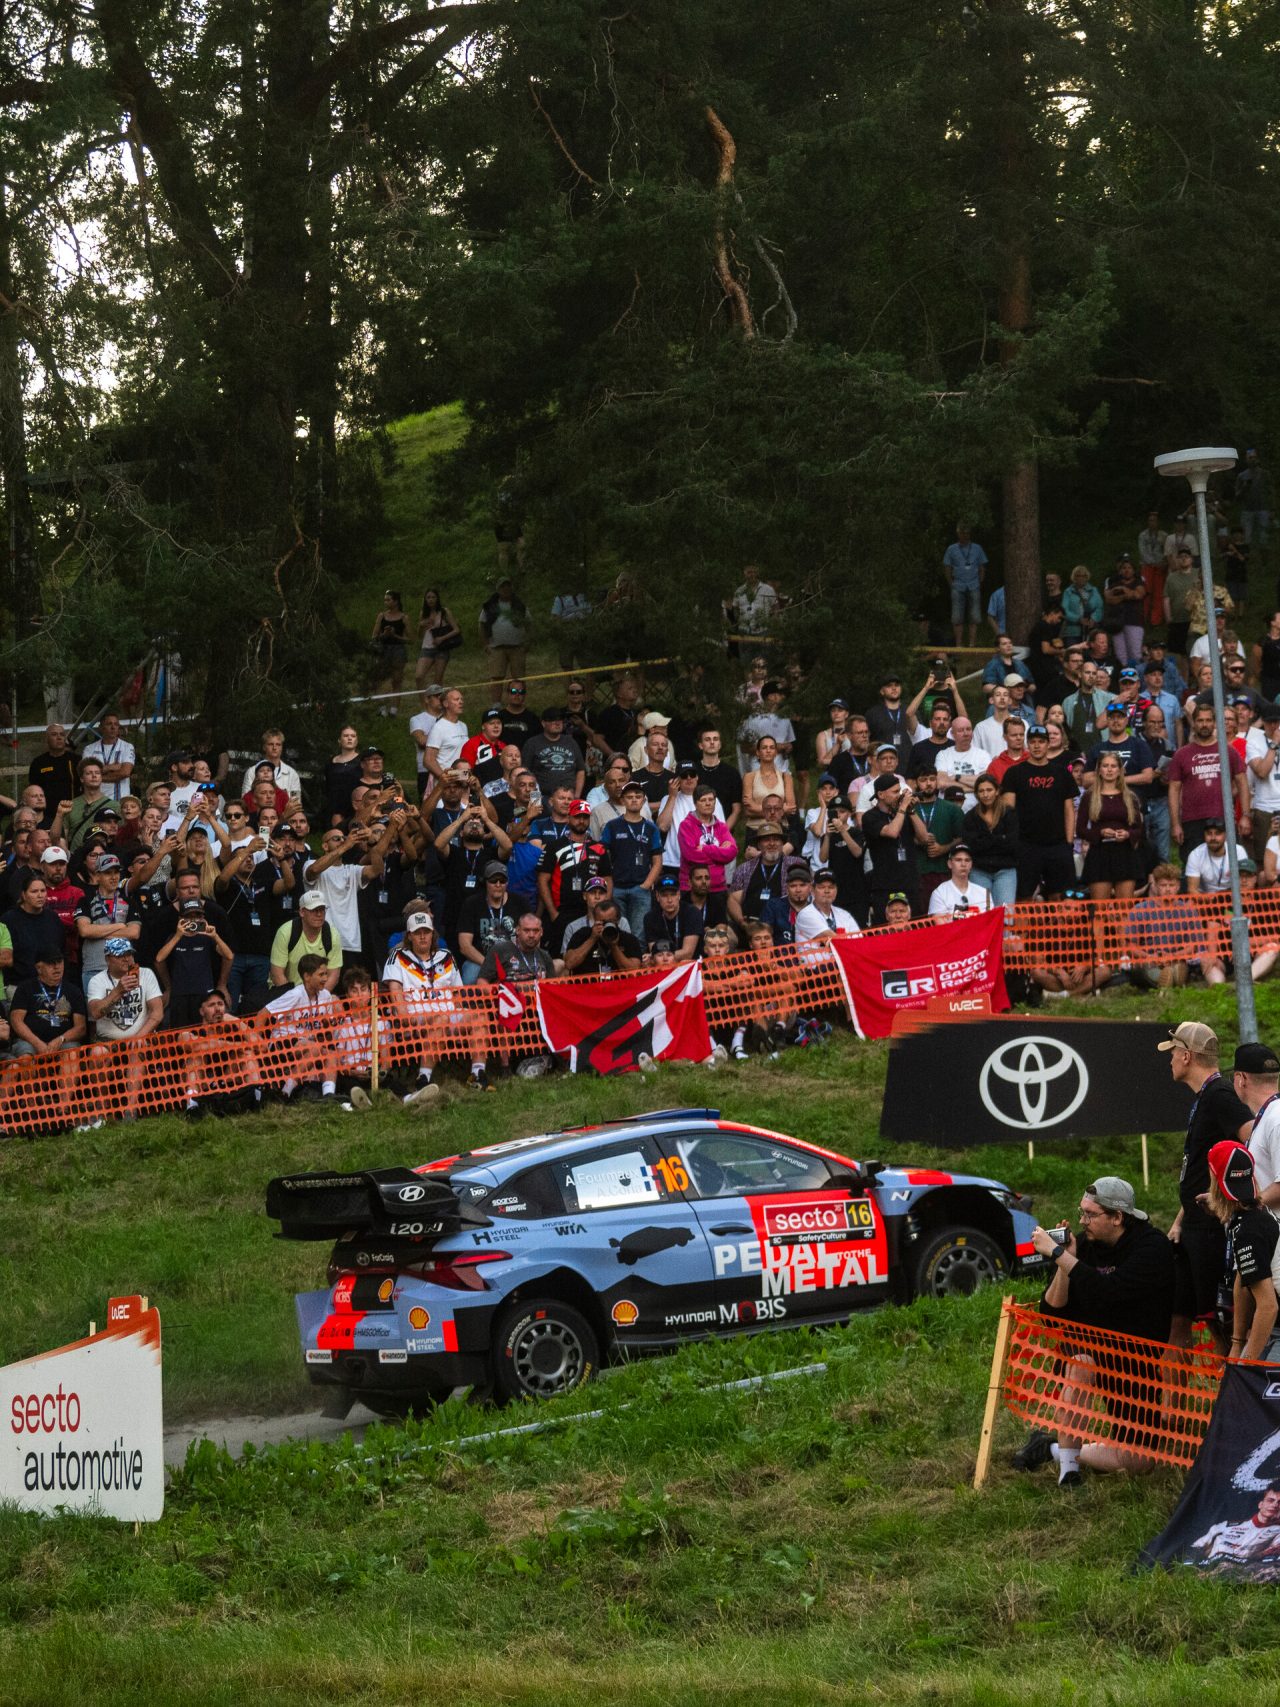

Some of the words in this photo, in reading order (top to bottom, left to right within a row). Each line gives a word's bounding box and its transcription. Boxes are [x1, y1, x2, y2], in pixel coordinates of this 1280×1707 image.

[1028, 776, 1055, 789] 1892
[884, 976, 935, 998] GR
[949, 999, 984, 1012] WRC
[782, 1155, 809, 1171] HYUNDAI
[656, 1155, 690, 1193] 16
[775, 1208, 837, 1230] secto
[848, 1204, 871, 1226] 16
[490, 1226, 529, 1236] HYUNDAI
[492, 1234, 521, 1242] STEEL
[798, 1232, 847, 1243] SafetyCulture
[714, 1240, 840, 1275] PEDAL
[762, 1254, 888, 1298] METAL
[111, 1304, 130, 1320] WRC
[665, 1310, 717, 1326] HYUNDAI
[719, 1298, 788, 1325] MOBIS
[416, 1337, 443, 1345] HYUNDAI
[11, 1382, 81, 1434] secto
[24, 1436, 143, 1492] automotive
